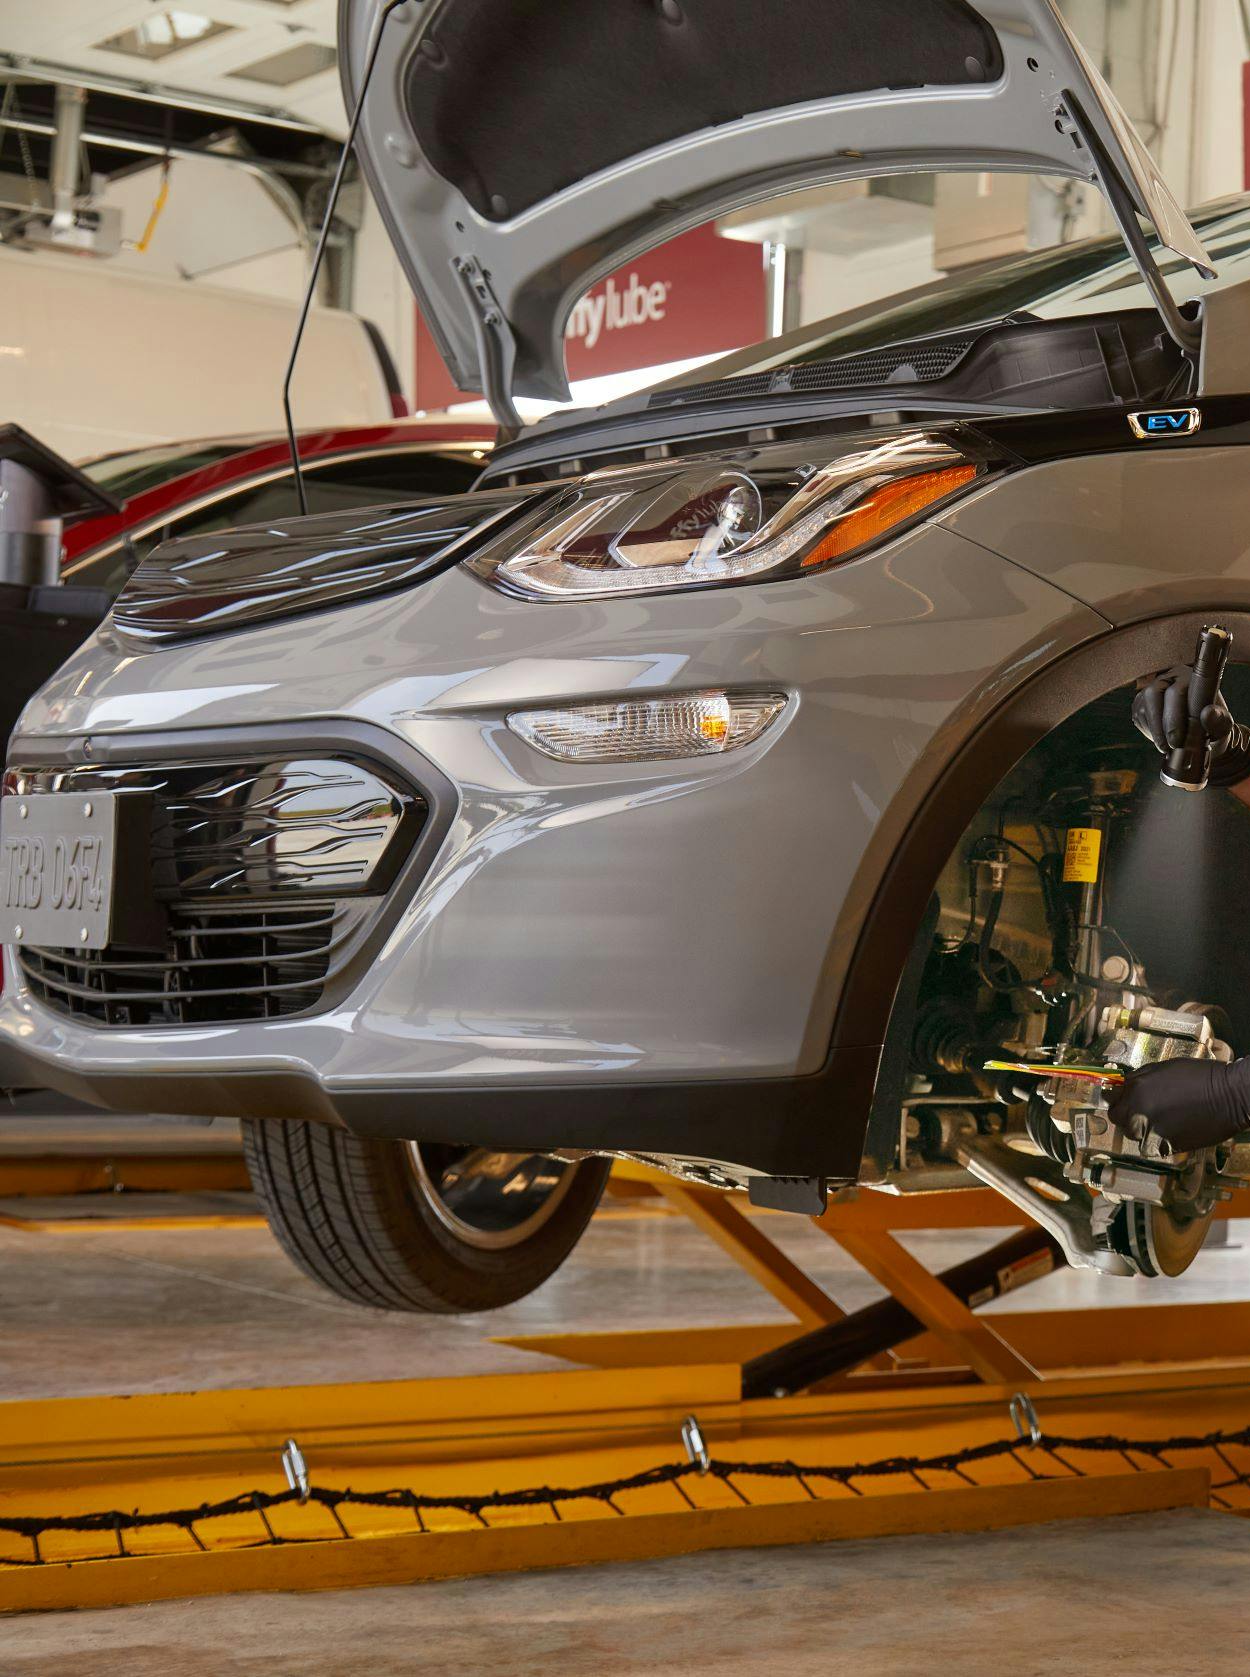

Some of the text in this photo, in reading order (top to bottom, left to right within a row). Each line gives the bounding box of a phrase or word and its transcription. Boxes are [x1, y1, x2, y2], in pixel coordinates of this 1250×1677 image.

[1148, 413, 1188, 430] EV
[5, 836, 104, 912] TRB 06F4
